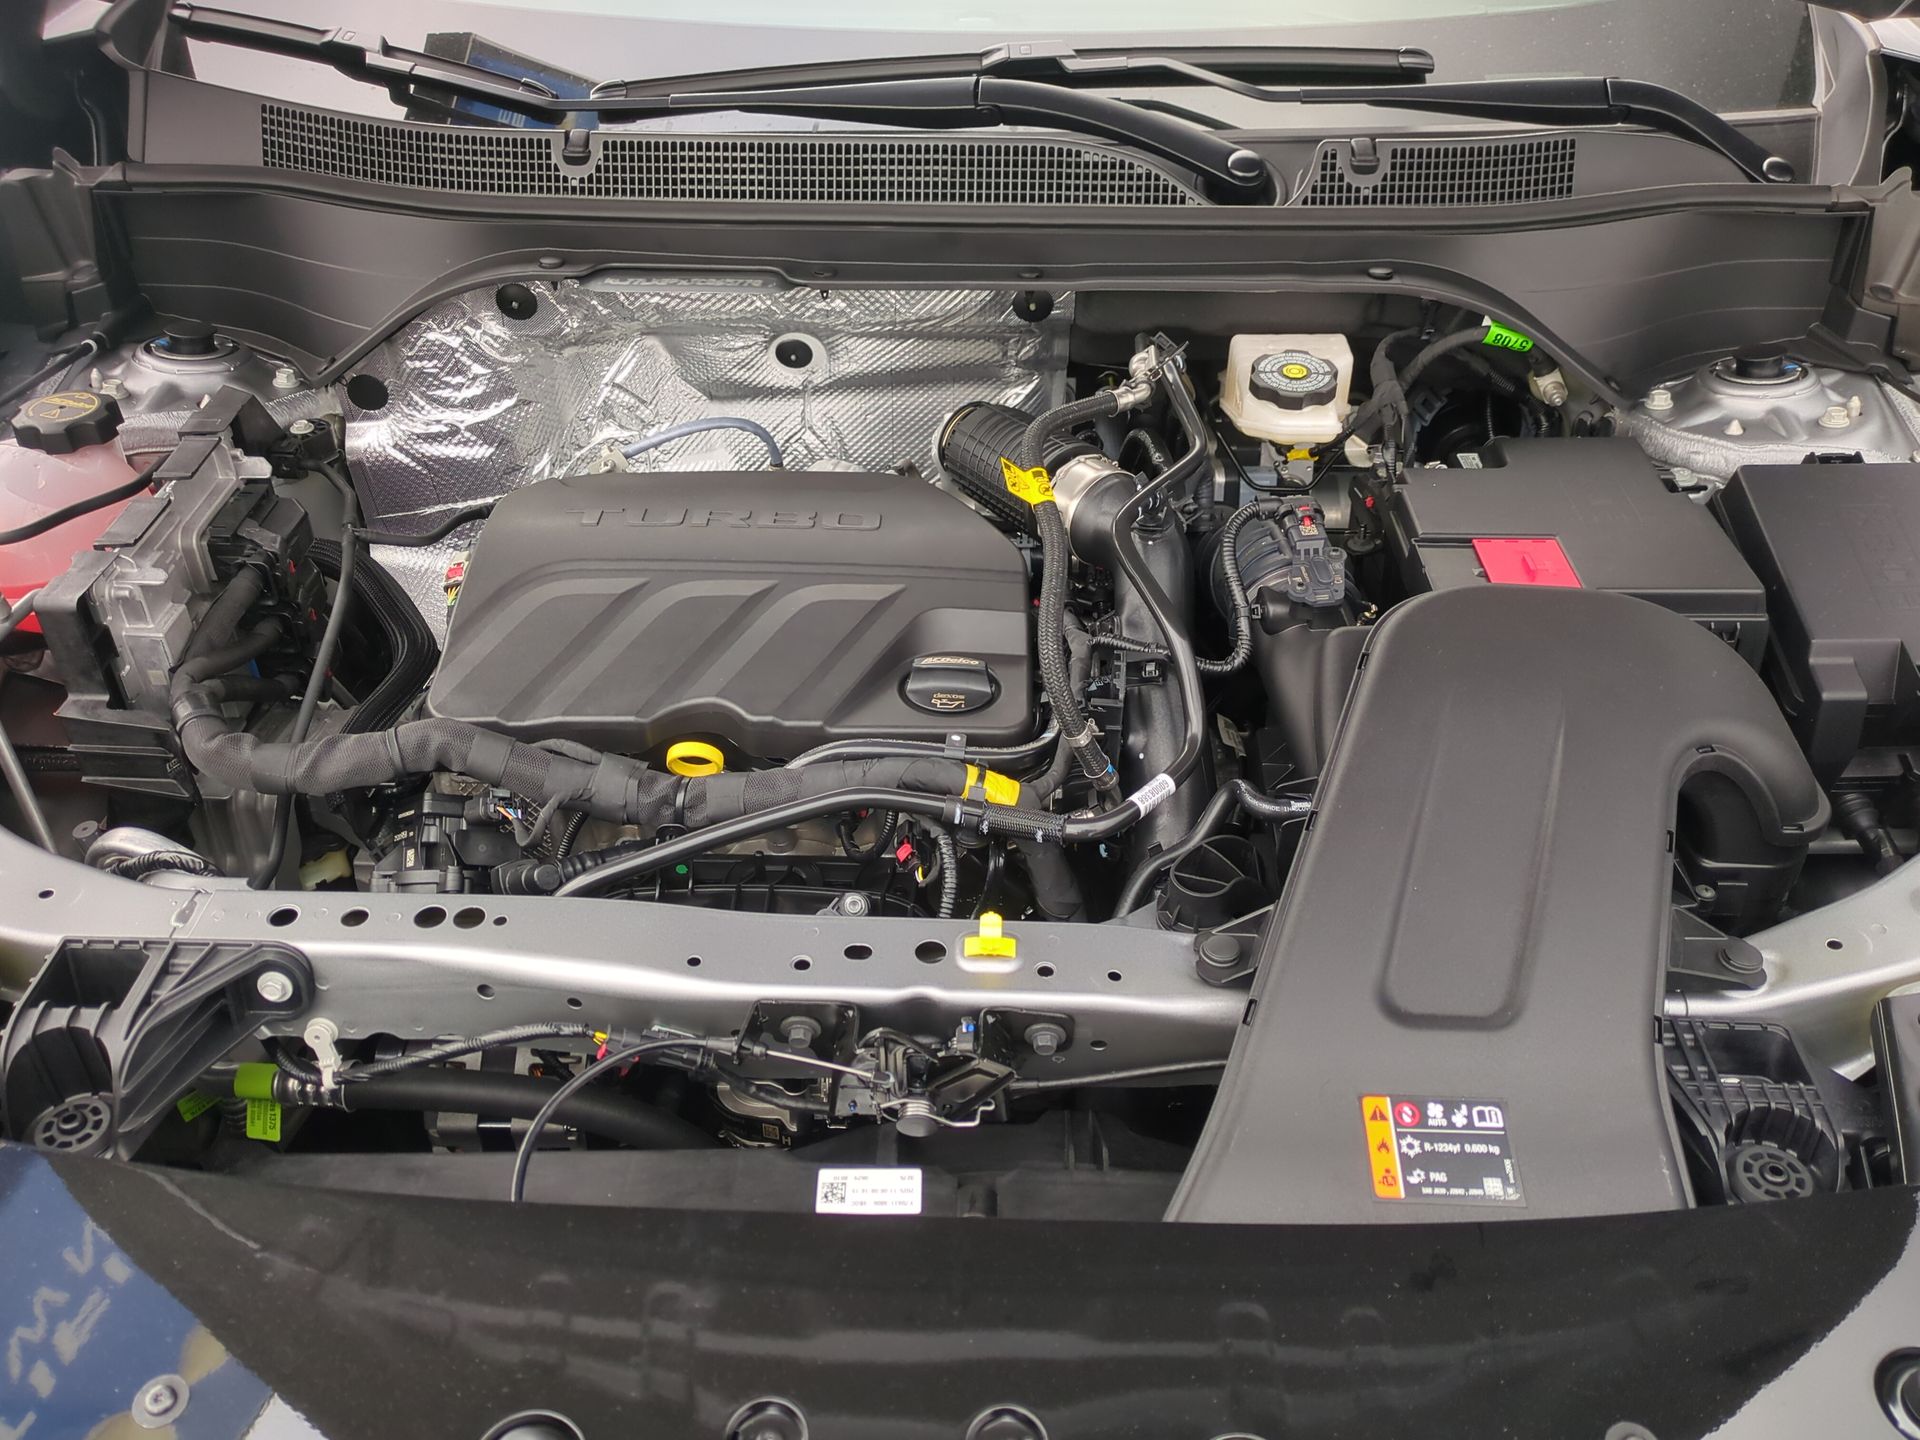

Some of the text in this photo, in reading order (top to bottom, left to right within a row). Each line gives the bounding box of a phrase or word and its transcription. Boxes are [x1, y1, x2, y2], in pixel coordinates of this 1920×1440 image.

[1493, 333, 1529, 350] 5708
[565, 508, 883, 530] TURBO
[920, 656, 979, 665] ACDelco
[1428, 1118, 1447, 1127] AUTO
[1423, 1141, 1461, 1154] R-1234yf
[1488, 1143, 1501, 1156] kg
[1429, 1171, 1448, 1183] PAG
